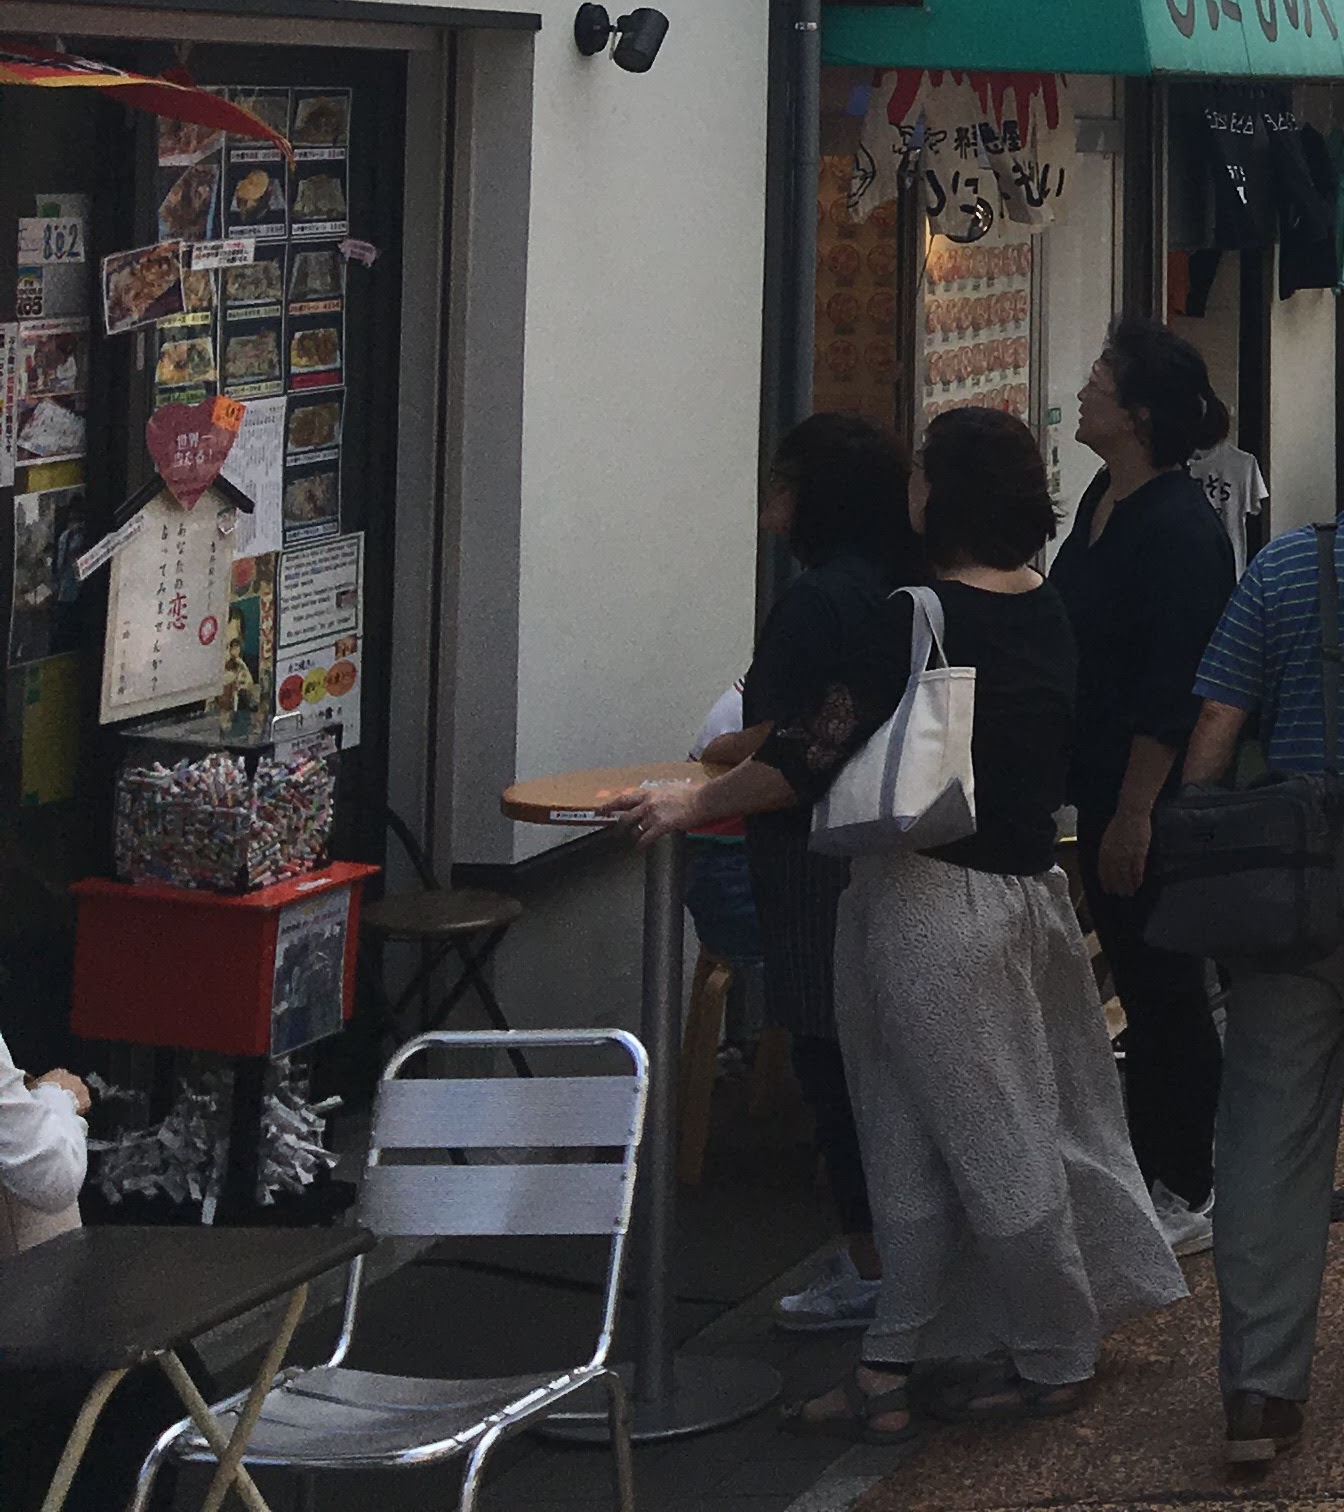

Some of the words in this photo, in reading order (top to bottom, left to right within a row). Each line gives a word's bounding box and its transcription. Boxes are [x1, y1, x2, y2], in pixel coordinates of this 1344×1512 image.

[166, 522, 188, 631] あなたの恋
